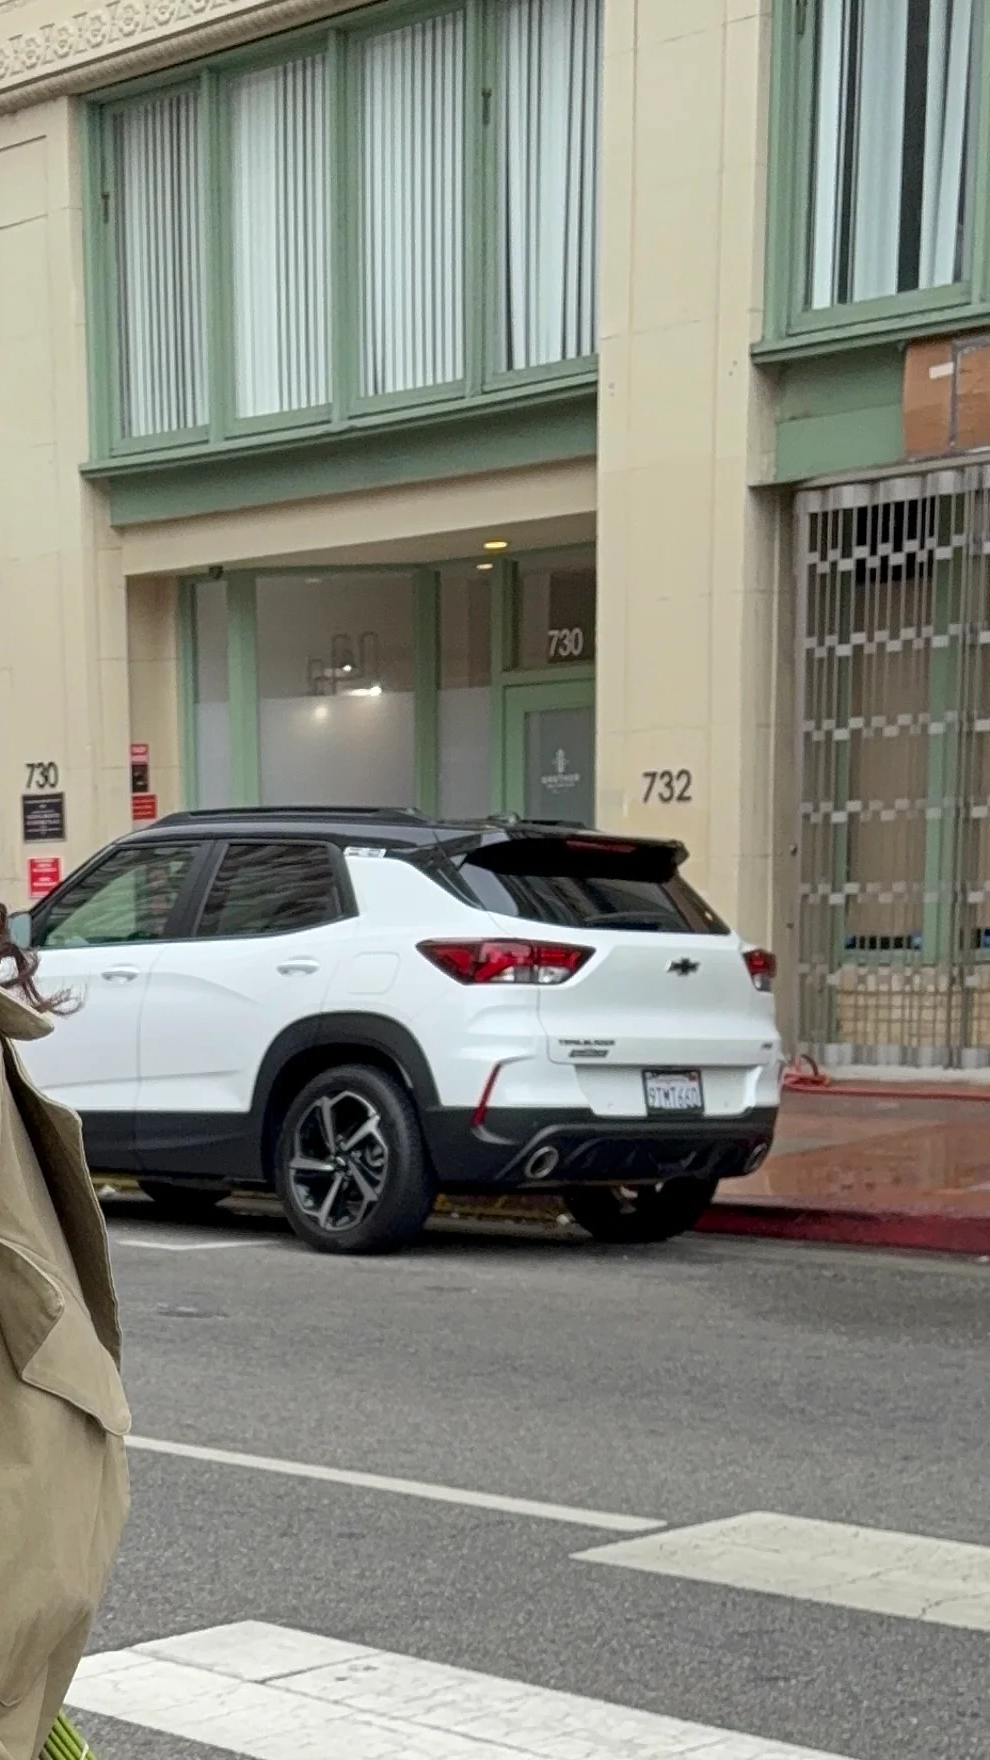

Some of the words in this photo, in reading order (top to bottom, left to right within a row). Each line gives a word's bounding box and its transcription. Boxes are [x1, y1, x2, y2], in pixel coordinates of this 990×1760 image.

[547, 627, 584, 657] 730
[25, 761, 59, 789] 730
[641, 768, 692, 804] 732
